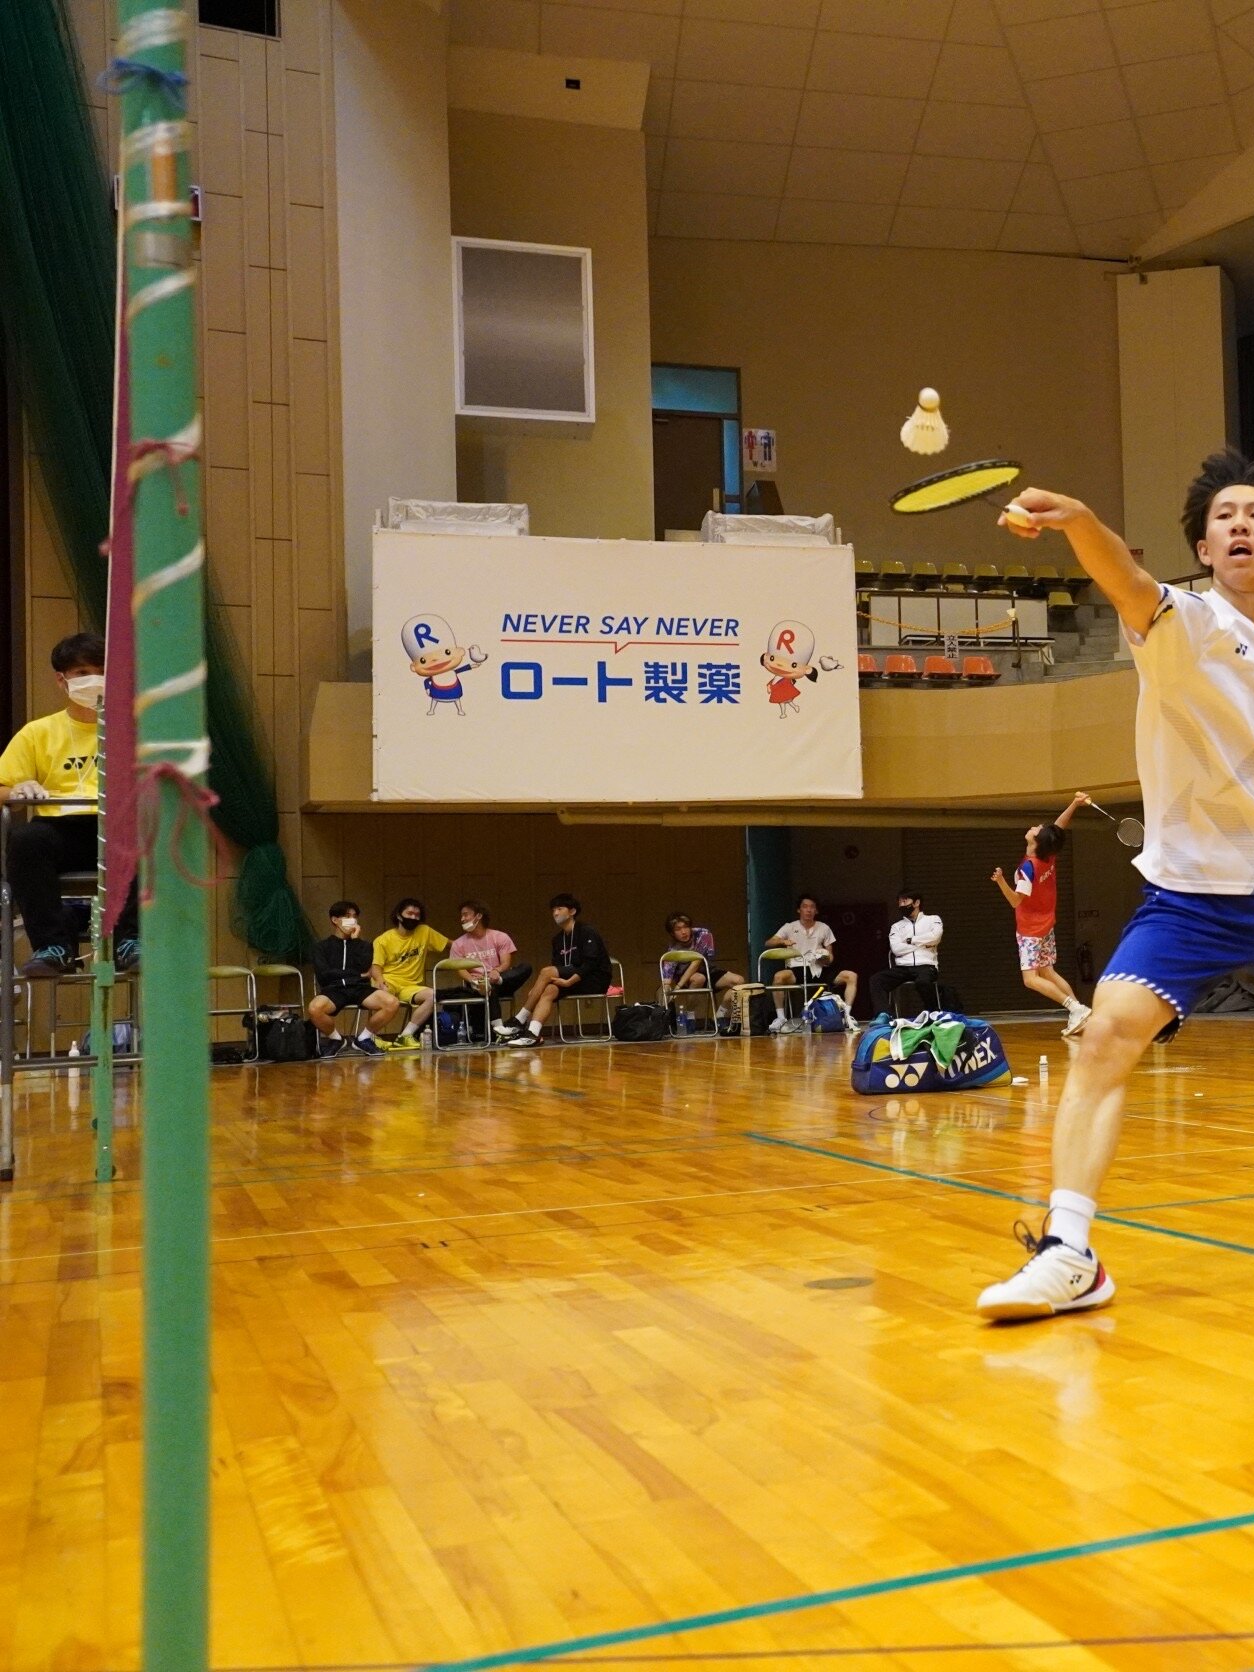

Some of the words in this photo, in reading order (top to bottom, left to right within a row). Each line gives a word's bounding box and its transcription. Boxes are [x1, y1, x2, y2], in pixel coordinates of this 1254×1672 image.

[501, 614, 591, 634] NEVER
[600, 616, 648, 635] SAY
[655, 617, 740, 637] NEVER
[500, 660, 741, 704] ロート製薬
[936, 1037, 998, 1079] ONEX
